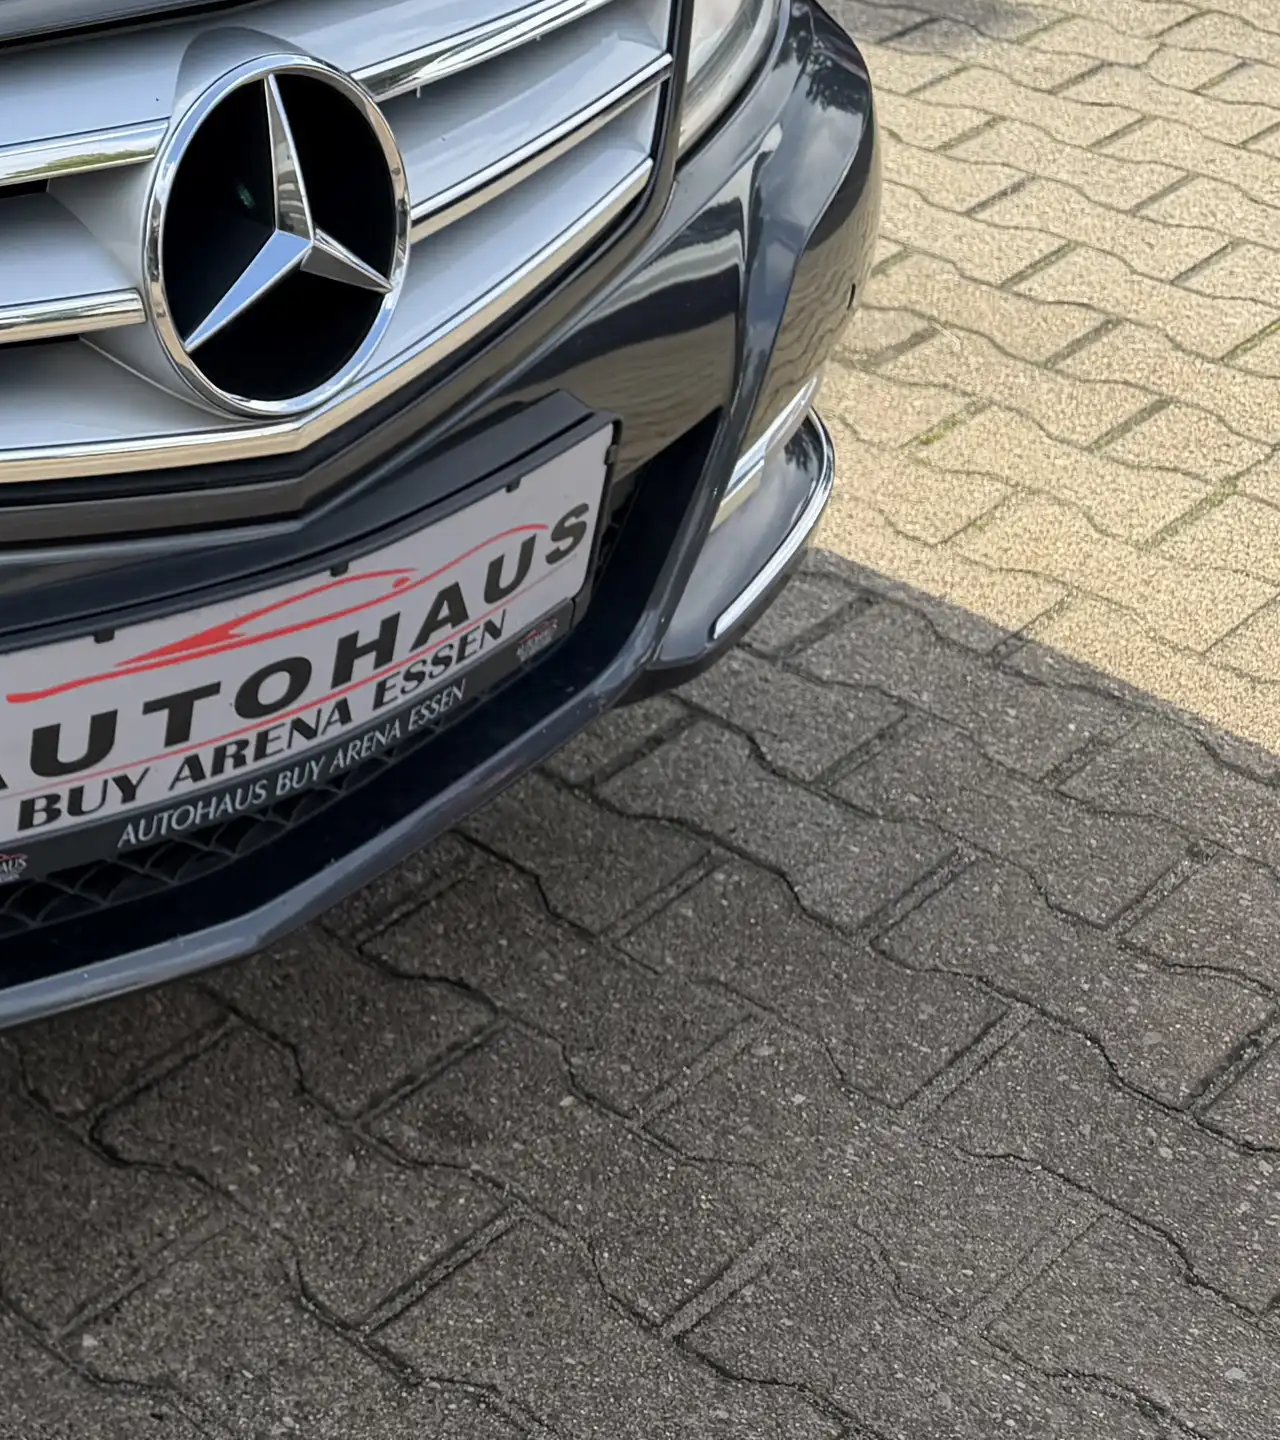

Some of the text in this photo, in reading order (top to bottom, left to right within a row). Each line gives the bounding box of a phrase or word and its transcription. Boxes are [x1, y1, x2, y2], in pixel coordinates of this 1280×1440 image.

[17, 766, 151, 832] BUY
[170, 702, 354, 791] ARENA
[372, 608, 507, 710] ESSEN
[117, 678, 467, 848] AUTOHAUS BUY ARENA ESSEN
